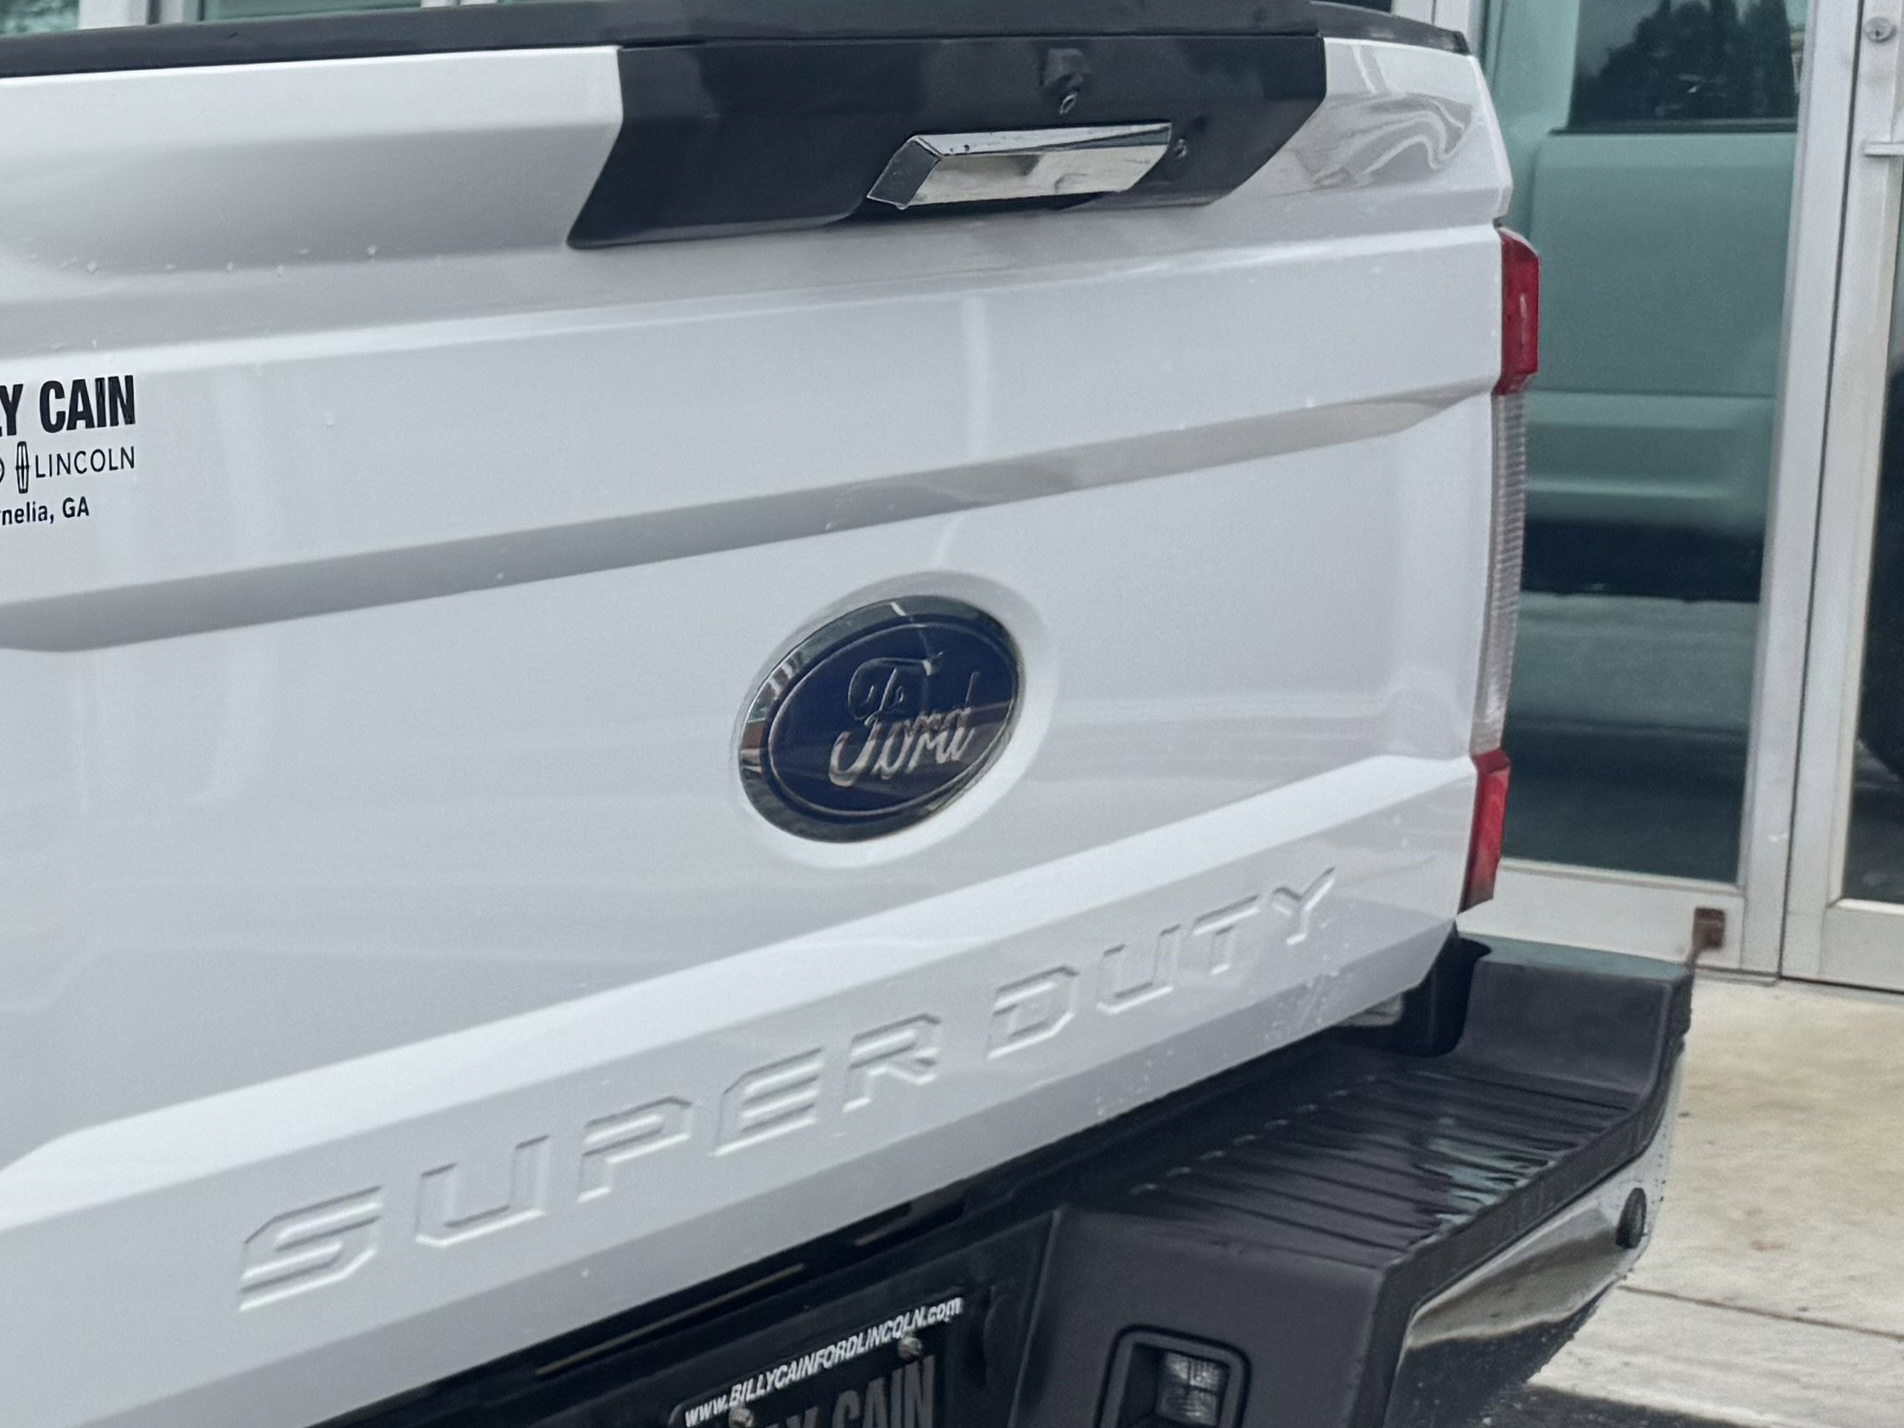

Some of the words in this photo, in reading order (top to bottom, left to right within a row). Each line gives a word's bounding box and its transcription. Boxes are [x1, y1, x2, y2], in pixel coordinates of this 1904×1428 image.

[39, 375, 136, 433] CAIN
[35, 445, 135, 479] LINCOLN
[62, 496, 90, 519] GA
[238, 1013, 943, 1311] SUPER
[985, 866, 1339, 1059] DUTY
[685, 1297, 963, 1428] www.BILLYCAINFORDLINCOLN.com
